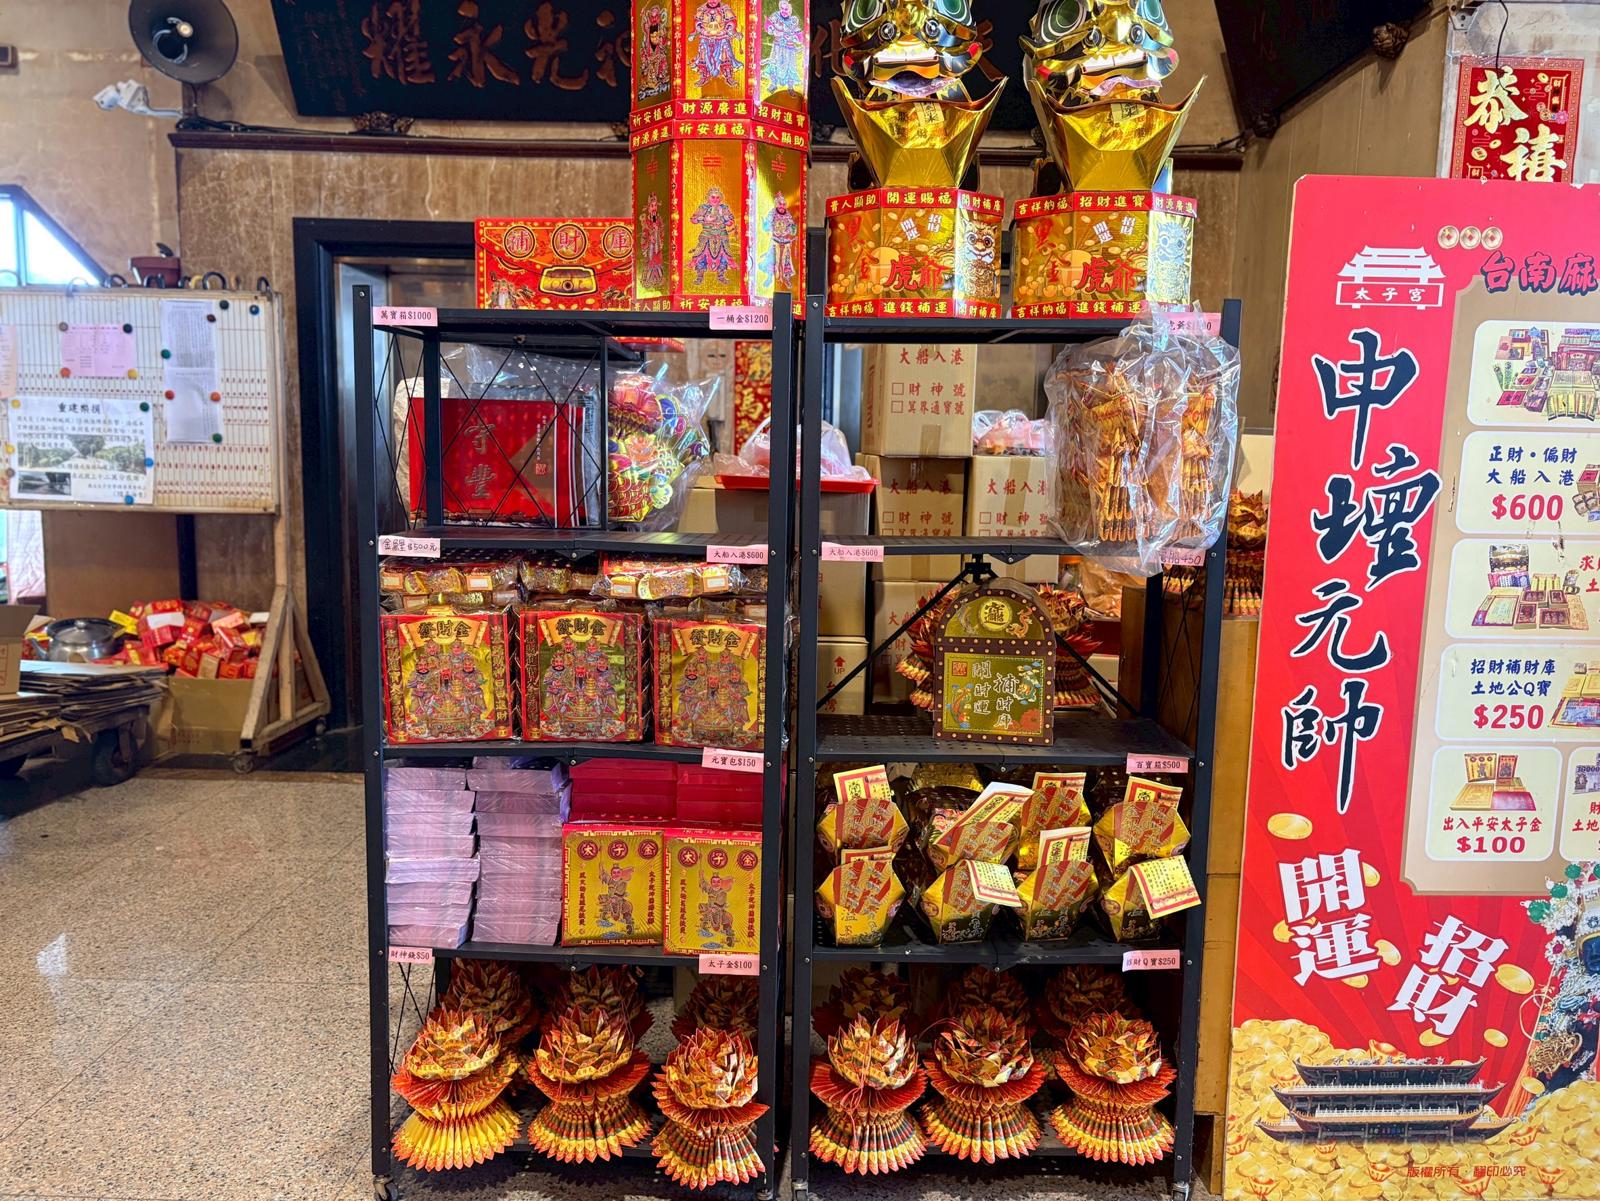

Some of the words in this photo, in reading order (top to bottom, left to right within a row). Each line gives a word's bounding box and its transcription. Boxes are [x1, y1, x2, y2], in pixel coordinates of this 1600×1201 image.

[682, 101, 748, 115] 財源廣進
[758, 106, 806, 129] 招財進寶
[886, 192, 952, 205] 開運賜福
[1018, 198, 1069, 215] 吉祥納福
[1079, 194, 1145, 208] 招財進寶
[508, 230, 630, 254] 補財庫
[884, 255, 951, 292] 虎爺
[1075, 257, 1143, 296] 虎爺
[1354, 287, 1427, 302] 太子宮
[828, 303, 875, 317] 吉祥納福
[883, 301, 949, 314] 進錢補運
[1016, 303, 1067, 318] 吉祥納福
[1076, 301, 1141, 314] 進錢補運
[716, 314, 769, 324] 一桶金$1200
[899, 347, 964, 365] 大船入港
[908, 382, 966, 397] 財神號
[1486, 468, 1574, 486] 大船入港
[889, 478, 952, 495] 大船入港
[1491, 494, 1564, 521] $600
[899, 511, 954, 525] 財神號
[713, 550, 764, 560] 大船入港$600
[828, 548, 879, 558] 大船入港$600
[1282, 327, 1443, 814] 中壇元帥
[1579, 555, 1600, 571] 求
[417, 620, 472, 638] 發財金
[556, 618, 608, 635] 發財金
[689, 629, 741, 648] 發財金
[1470, 659, 1556, 675] 招財補財庫
[1470, 680, 1552, 697] 土地公Q寶
[1473, 704, 1545, 729] $250
[711, 756, 756, 767] 元寶包$150
[1136, 760, 1181, 769] 百寶箱$500
[1443, 816, 1543, 832] 出入平安太子金
[581, 842, 656, 857] 太子金
[1456, 835, 1526, 854] $100
[681, 850, 757, 867] 太子金
[1278, 848, 1381, 986] 開運
[708, 960, 753, 969] 太子金$100
[1386, 914, 1509, 1035] 招財
